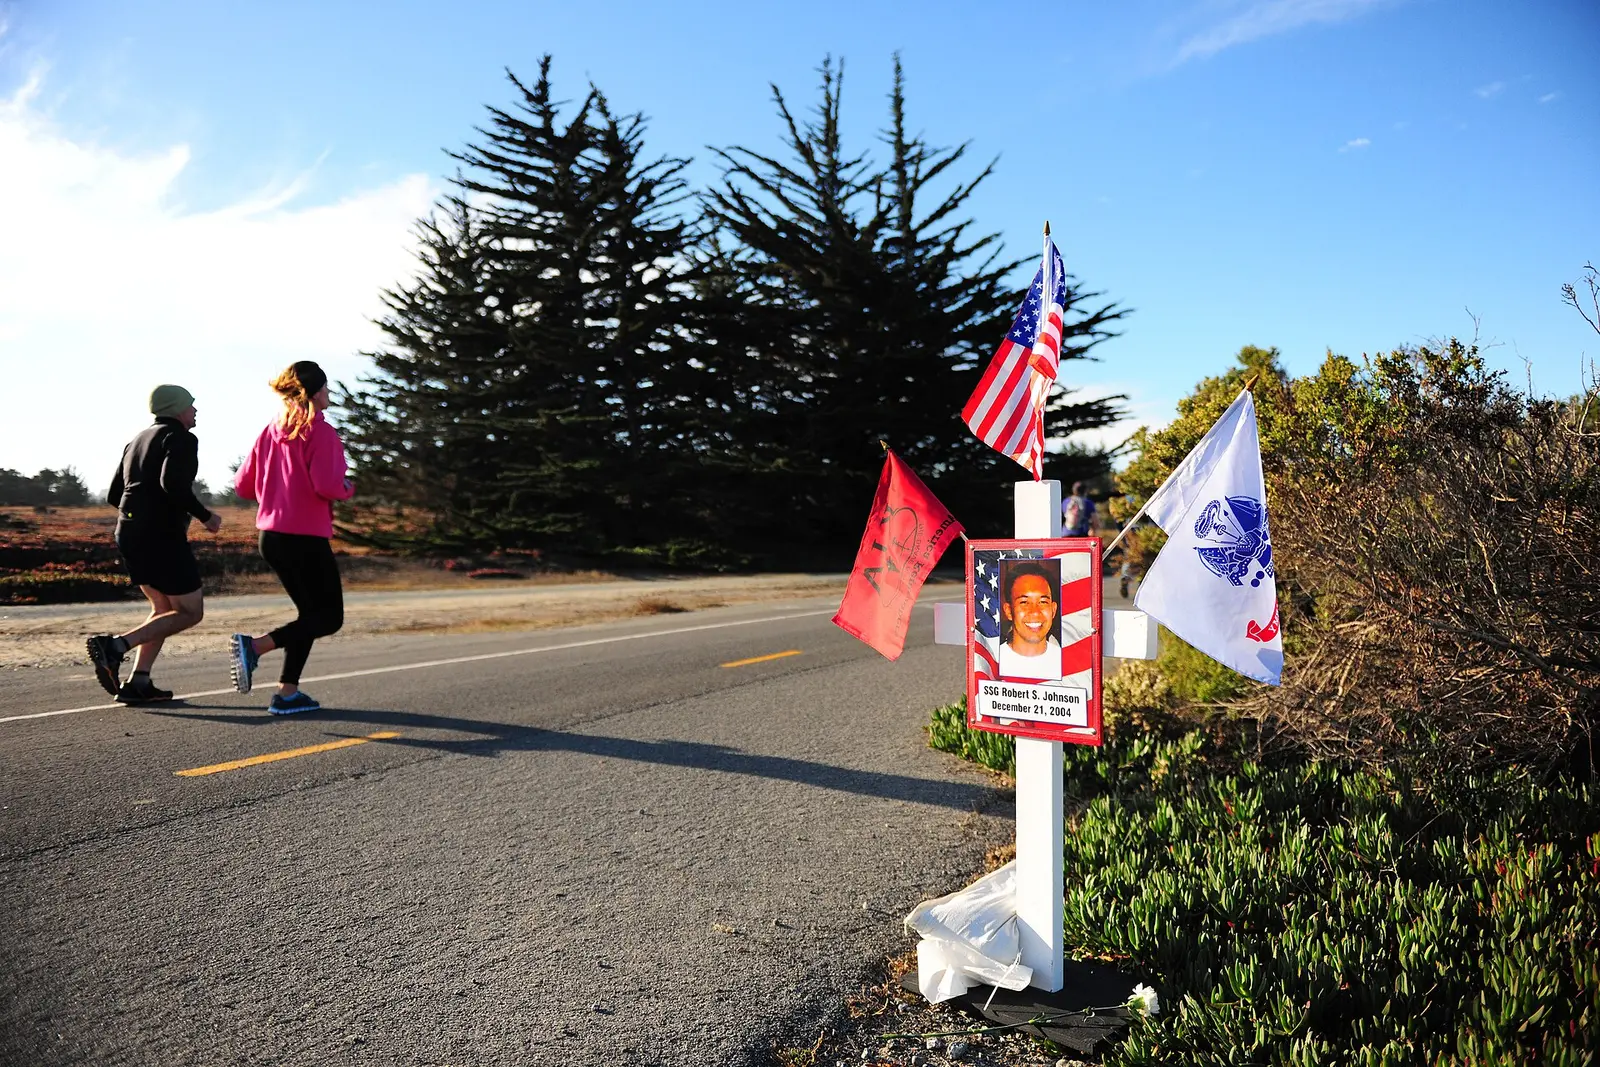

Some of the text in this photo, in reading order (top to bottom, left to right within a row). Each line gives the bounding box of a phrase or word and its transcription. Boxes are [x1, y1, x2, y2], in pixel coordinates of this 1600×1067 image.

[983, 685, 1080, 704] SSG Robert S. Johnson
[992, 701, 1071, 717] December 21, 2004
